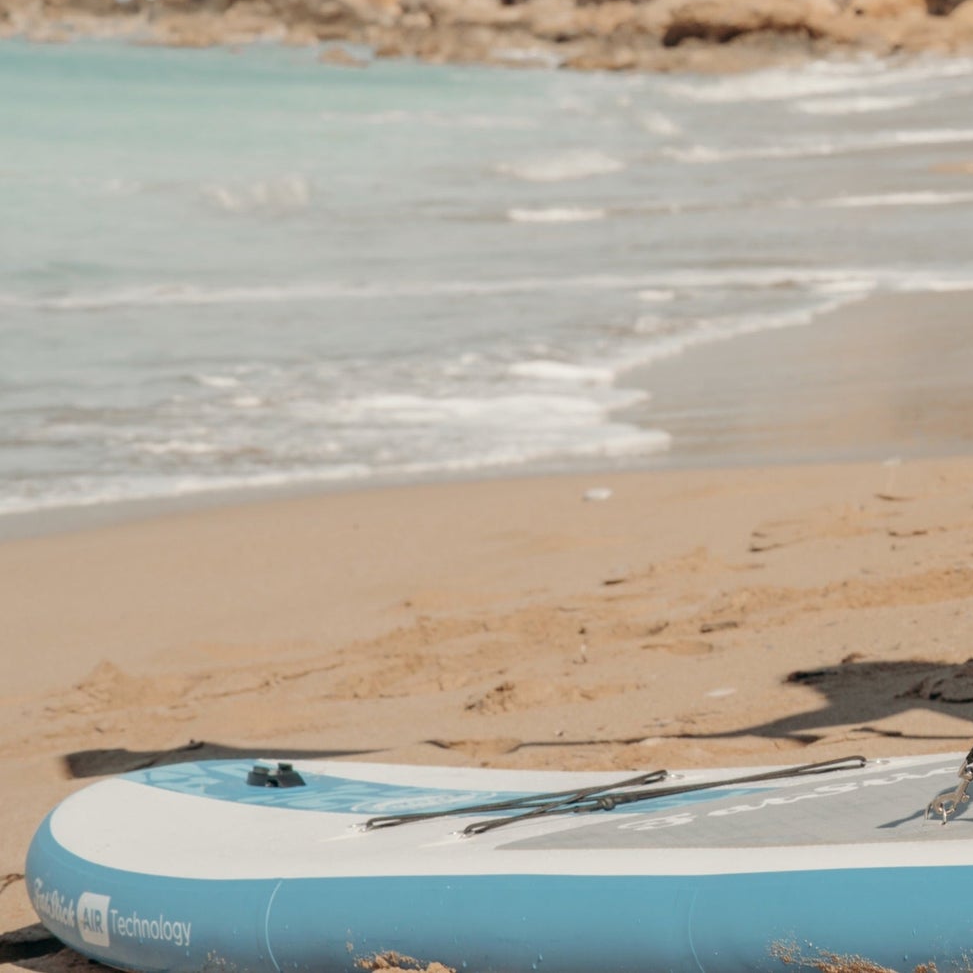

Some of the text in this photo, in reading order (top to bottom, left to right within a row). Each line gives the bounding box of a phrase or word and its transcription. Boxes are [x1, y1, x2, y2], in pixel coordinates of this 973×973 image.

[32, 877, 192, 947] FatStick AIR Technology
